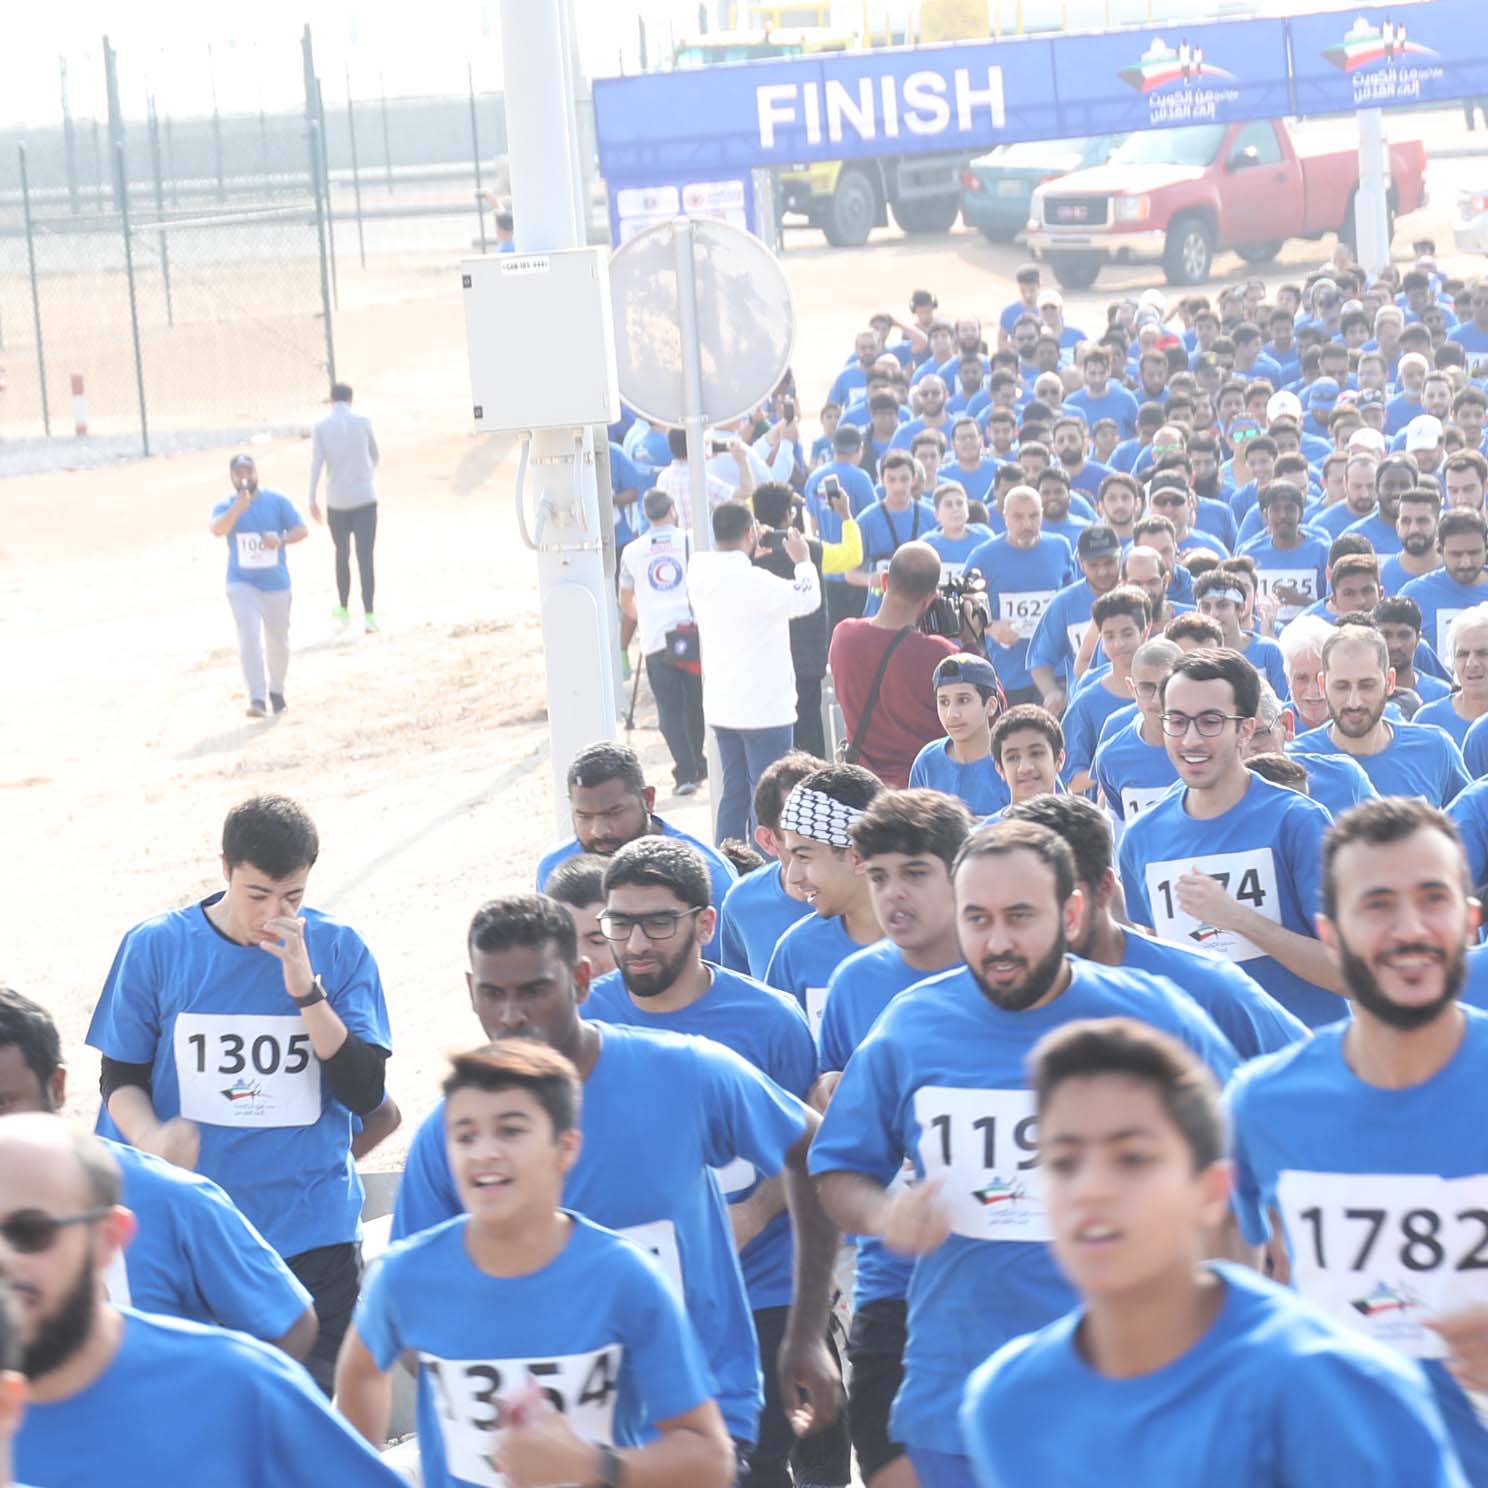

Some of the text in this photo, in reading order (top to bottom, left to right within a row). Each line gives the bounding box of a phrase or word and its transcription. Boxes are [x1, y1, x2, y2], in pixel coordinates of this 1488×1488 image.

[755, 65, 1006, 149] FINISH
[187, 1032, 310, 1076] 1305
[931, 1115, 1041, 1172] 119
